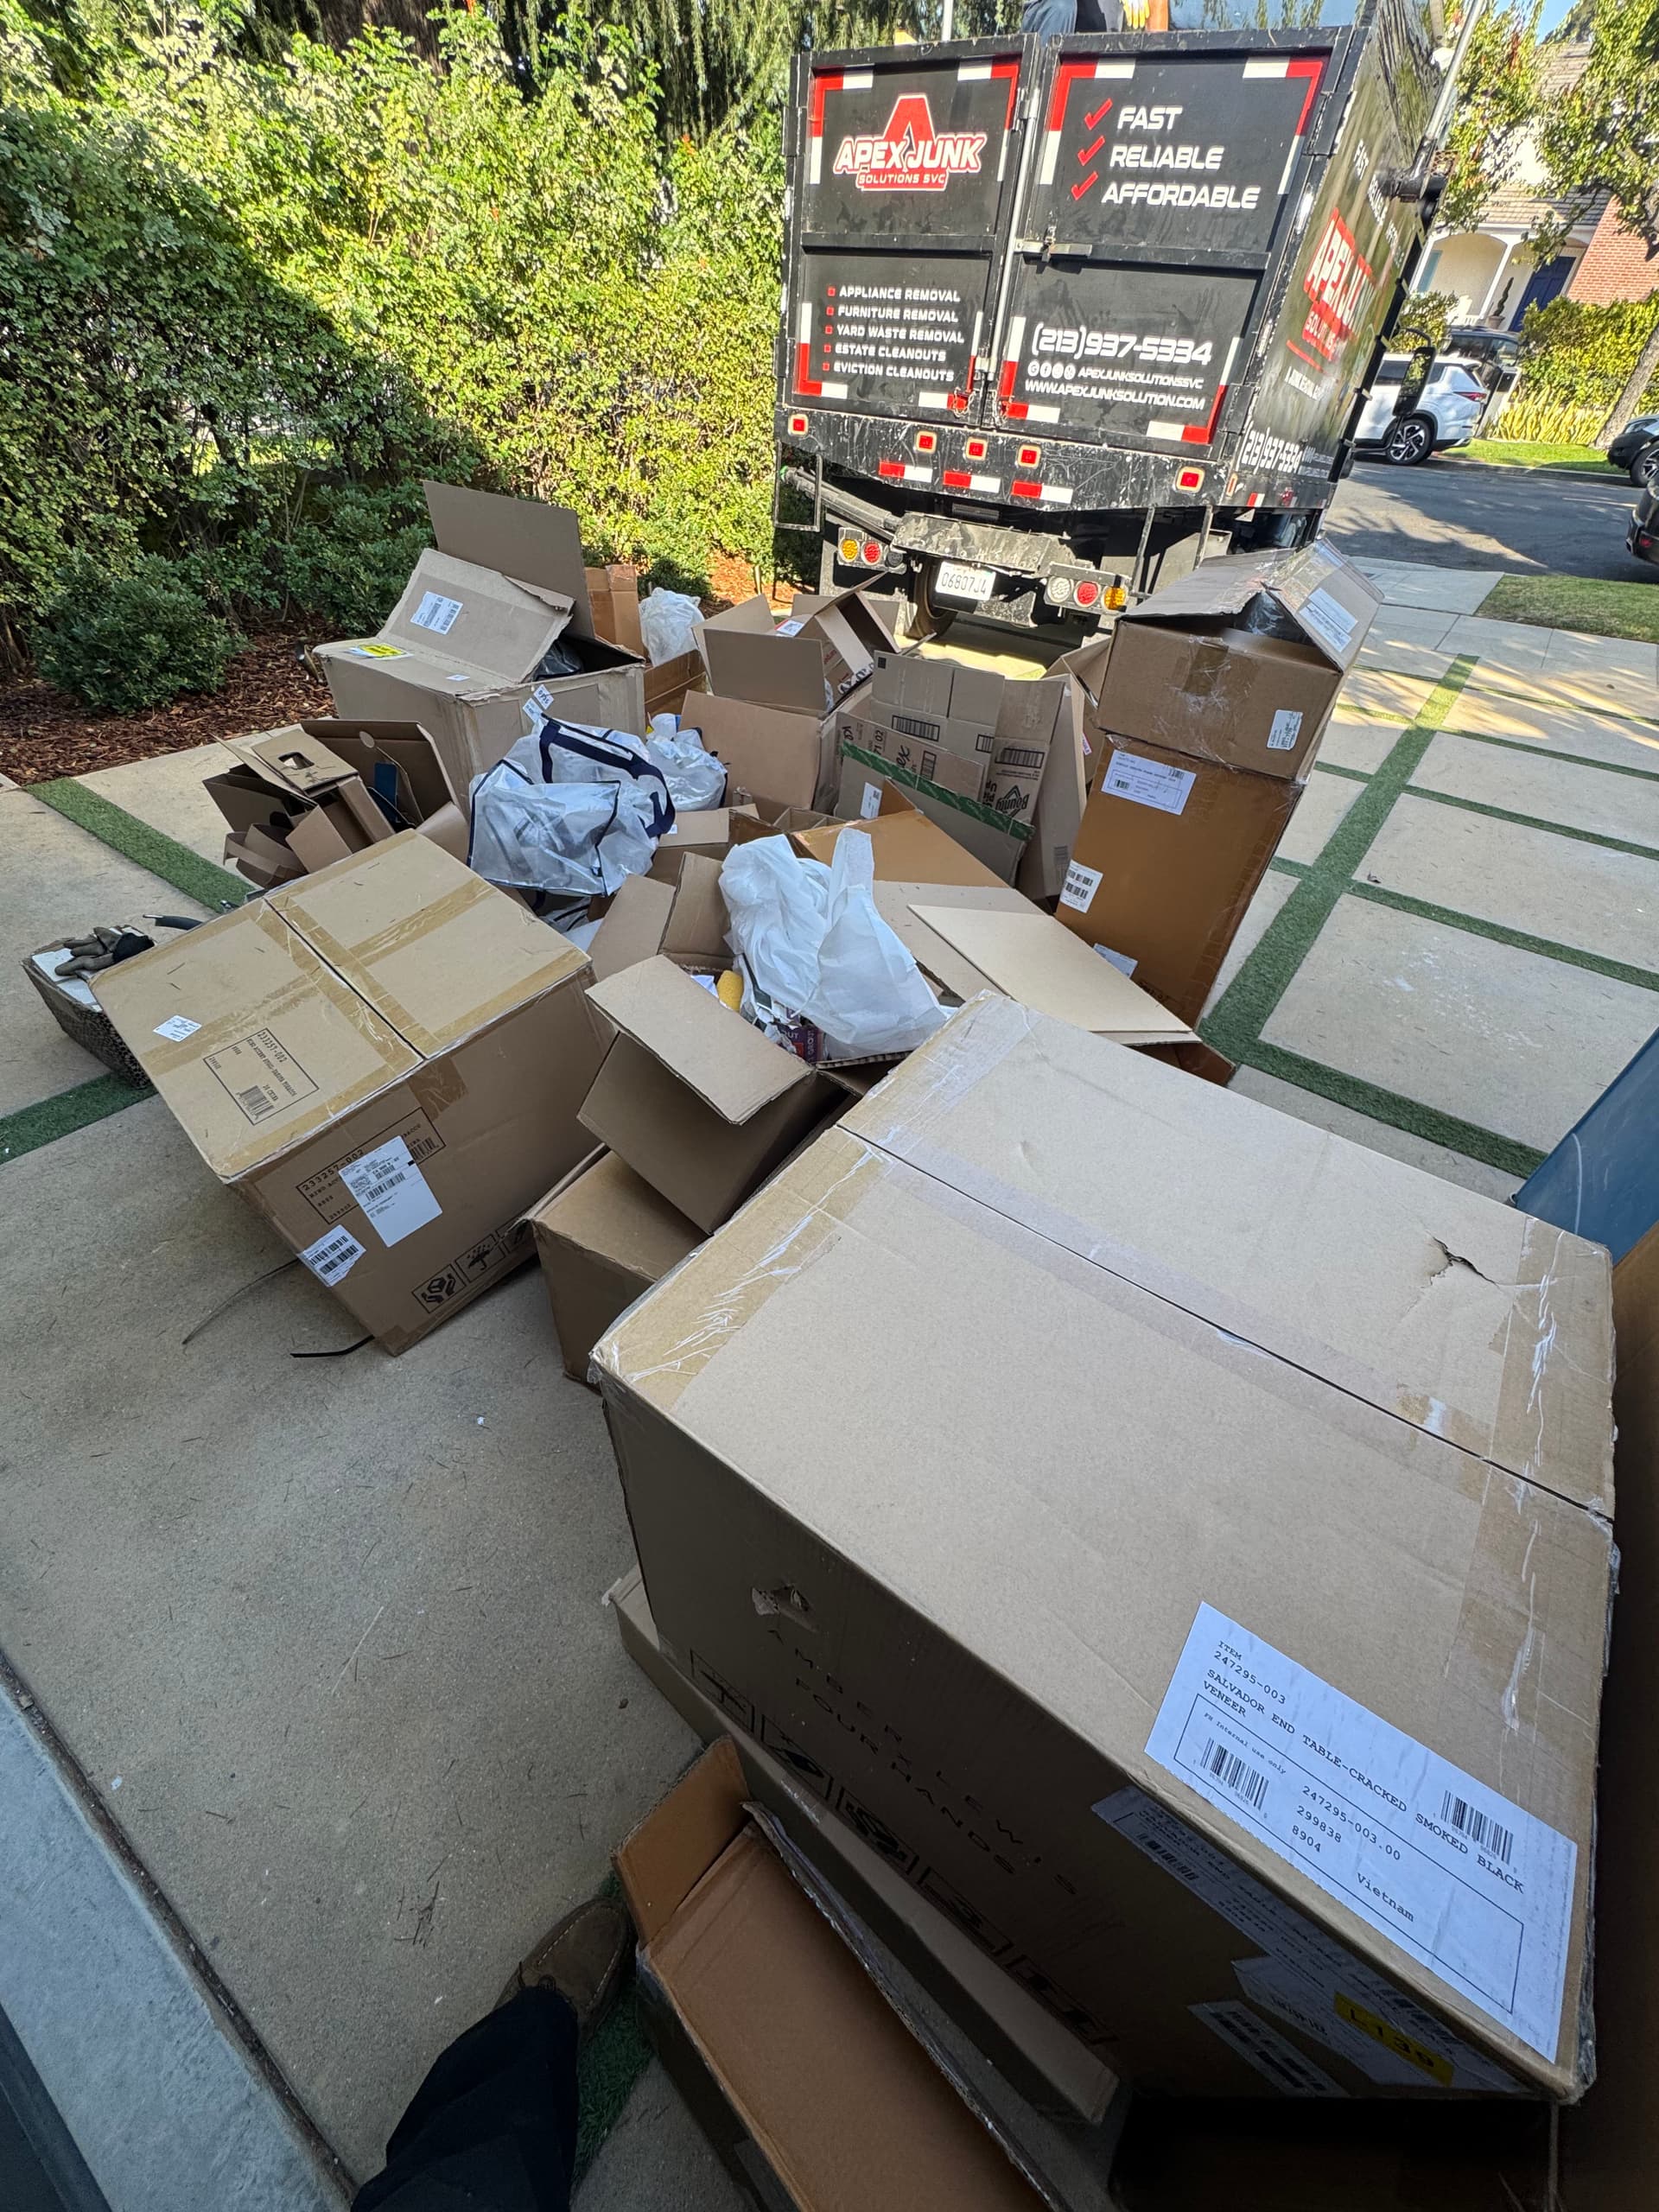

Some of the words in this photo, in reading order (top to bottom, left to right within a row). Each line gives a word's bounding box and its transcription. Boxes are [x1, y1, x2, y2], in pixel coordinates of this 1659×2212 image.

[1117, 105, 1183, 130] FAST
[836, 138, 906, 170] APEX
[907, 138, 983, 169] JUNK
[1109, 145, 1225, 170] RELIABLE
[858, 173, 919, 185] SOLUTIONS
[922, 173, 946, 184] SVC
[1102, 181, 1261, 209] AFFORDABLE
[839, 285, 901, 300] APPLIANCE
[905, 289, 961, 302] REMOVAL
[837, 305, 900, 320] FURNITURE
[903, 308, 959, 323] REMOVAL
[836, 324, 865, 338] YARD
[868, 326, 906, 340] WASTE
[909, 328, 965, 344] REMOVAL
[1031, 321, 1213, 365] (213)937-5334
[835, 342, 875, 356] ESTATE
[878, 346, 947, 362] CLEANOUTS
[833, 362, 883, 376] EVICTION
[886, 365, 955, 383] CLEANOUTS
[1077, 365, 1205, 389] APEXJUNKSOLUTIONSSVC
[1025, 378, 1205, 410] WWW.APEXJUNKSOLUTION.COM
[995, 792, 1030, 814] Bounty
[256, 1030, 289, 1064] 233257-002
[302, 1148, 365, 1192] 233257-002
[1217, 1640, 1243, 1661] ITEM
[1214, 1650, 1287, 1705] 247295-003
[1202, 1681, 1247, 1718] VENEER
[1216, 1721, 1249, 1747] Internal
[1251, 1747, 1265, 1760] use
[1268, 1758, 1287, 1775] only
[795, 1677, 879, 1756] FOUR
[892, 1761, 1015, 1875] HANDS
[1206, 1669, 1265, 1715] SALVADOR
[1271, 1713, 1295, 1735] END
[1302, 1734, 1407, 1813] TABLE-CRACKED
[1415, 1813, 1469, 1855] SMOKED
[1477, 1853, 1524, 1895] BLACK
[1296, 1805, 1343, 1844] 299838
[1302, 1785, 1401, 1861] 247295-003.00
[1292, 1825, 1322, 1853] 8904
[1357, 1872, 1414, 1923] Vietnam
